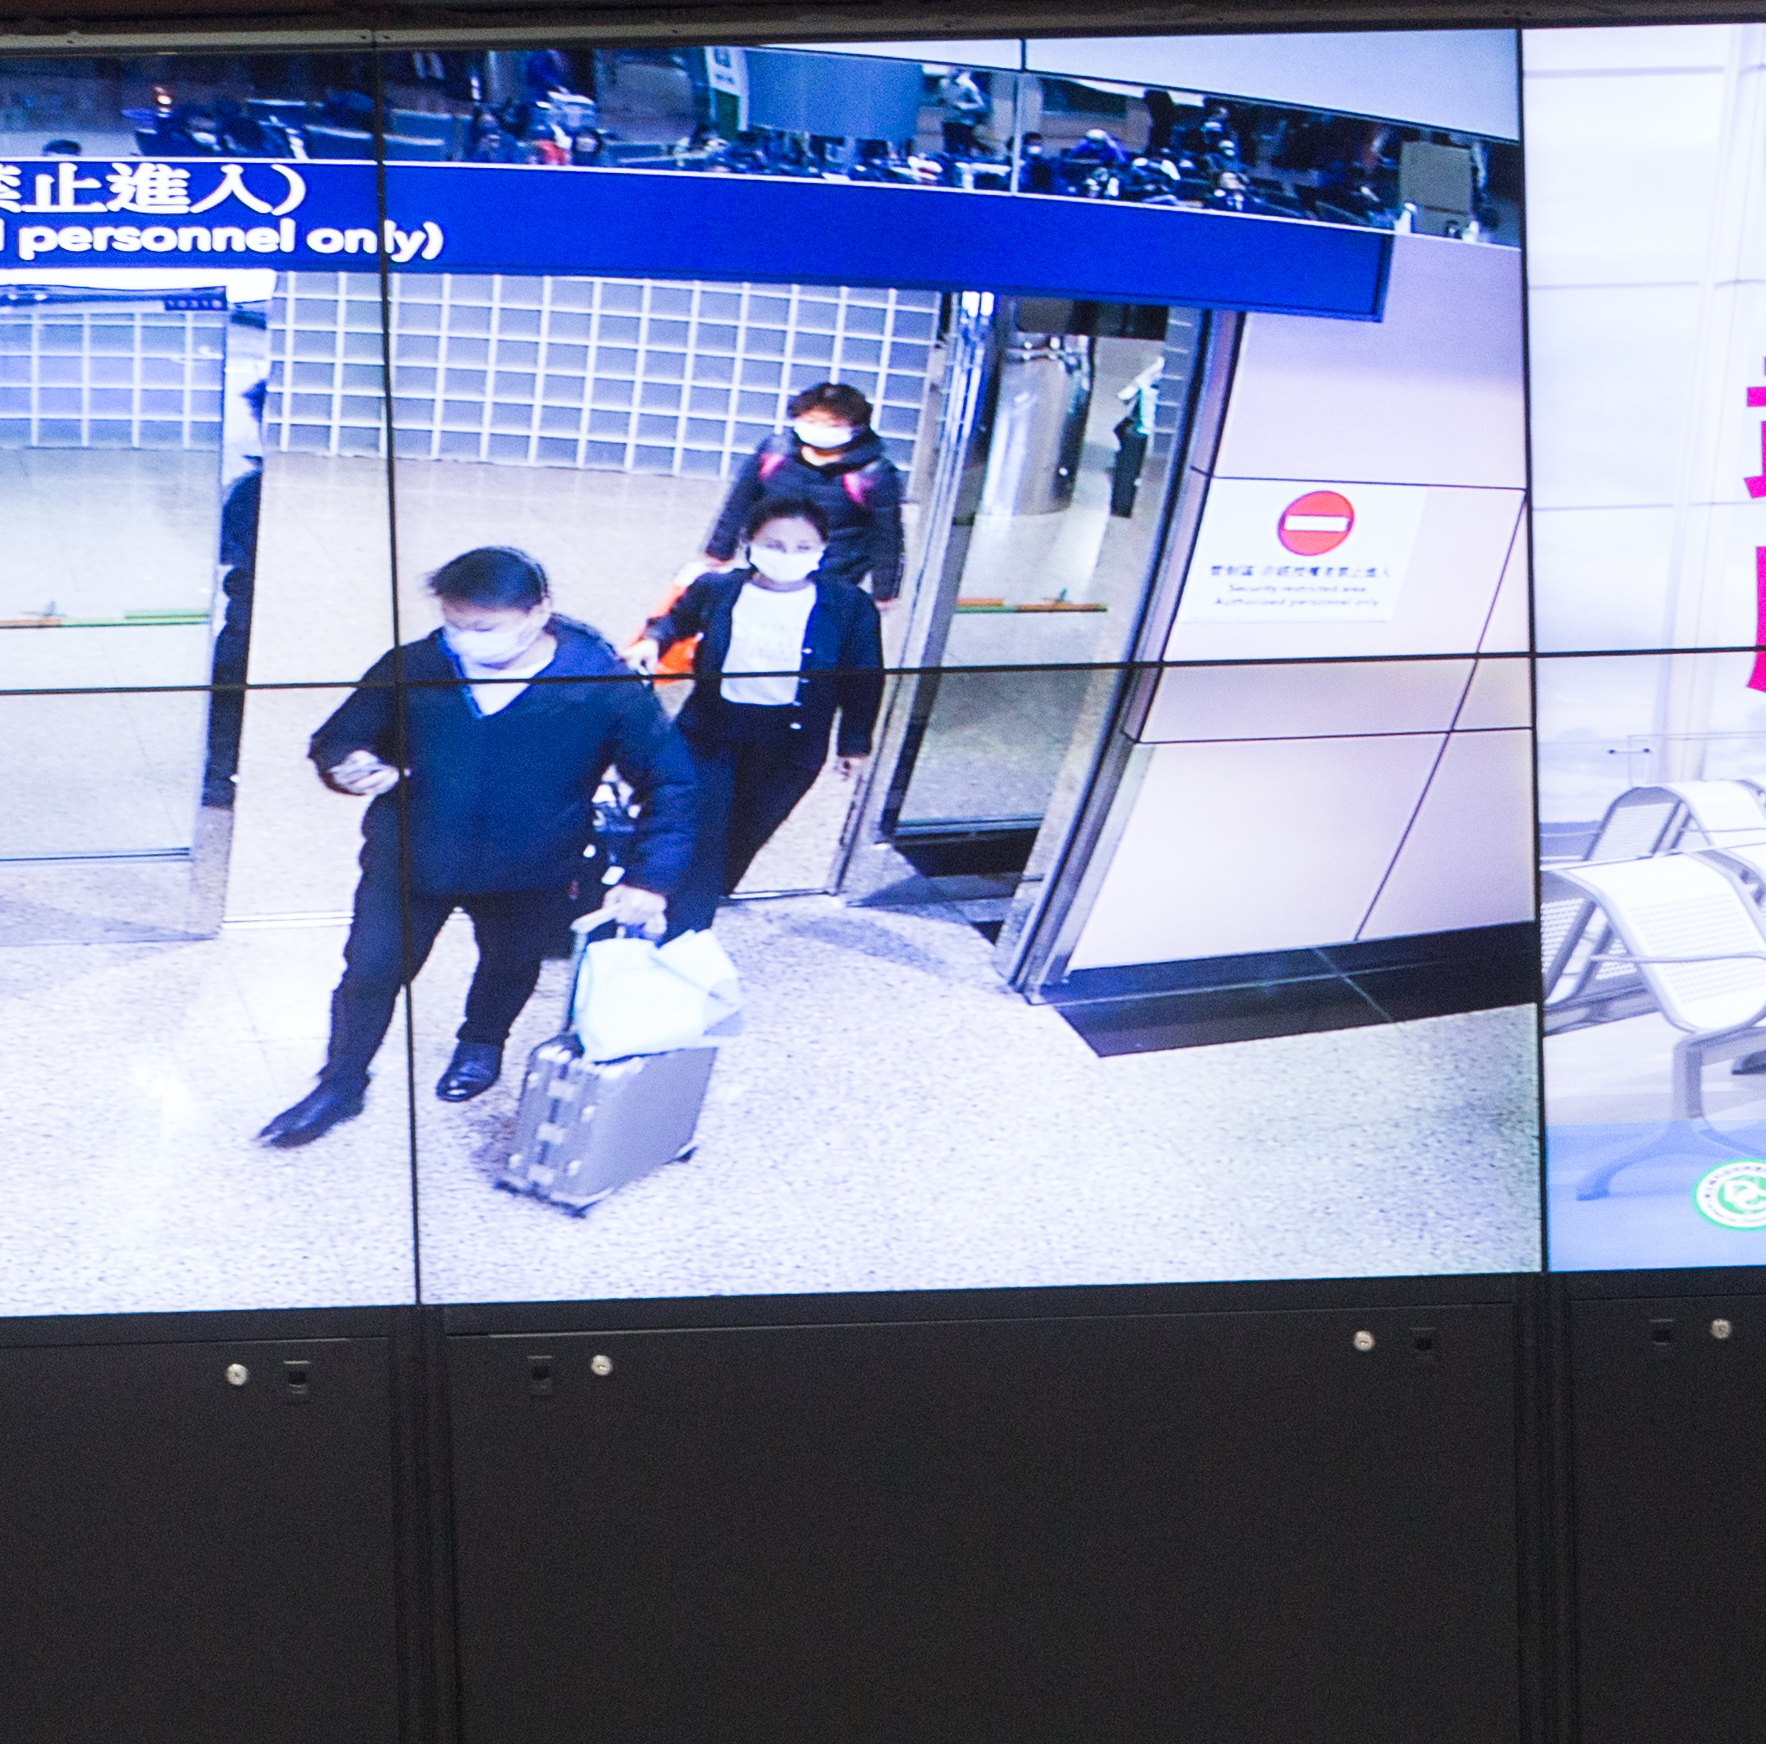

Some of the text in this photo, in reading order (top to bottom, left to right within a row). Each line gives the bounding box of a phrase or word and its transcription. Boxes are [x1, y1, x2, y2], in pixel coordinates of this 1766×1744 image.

[0, 163, 306, 216] 止進入)
[18, 218, 297, 261] personnel
[306, 220, 444, 263] only)
